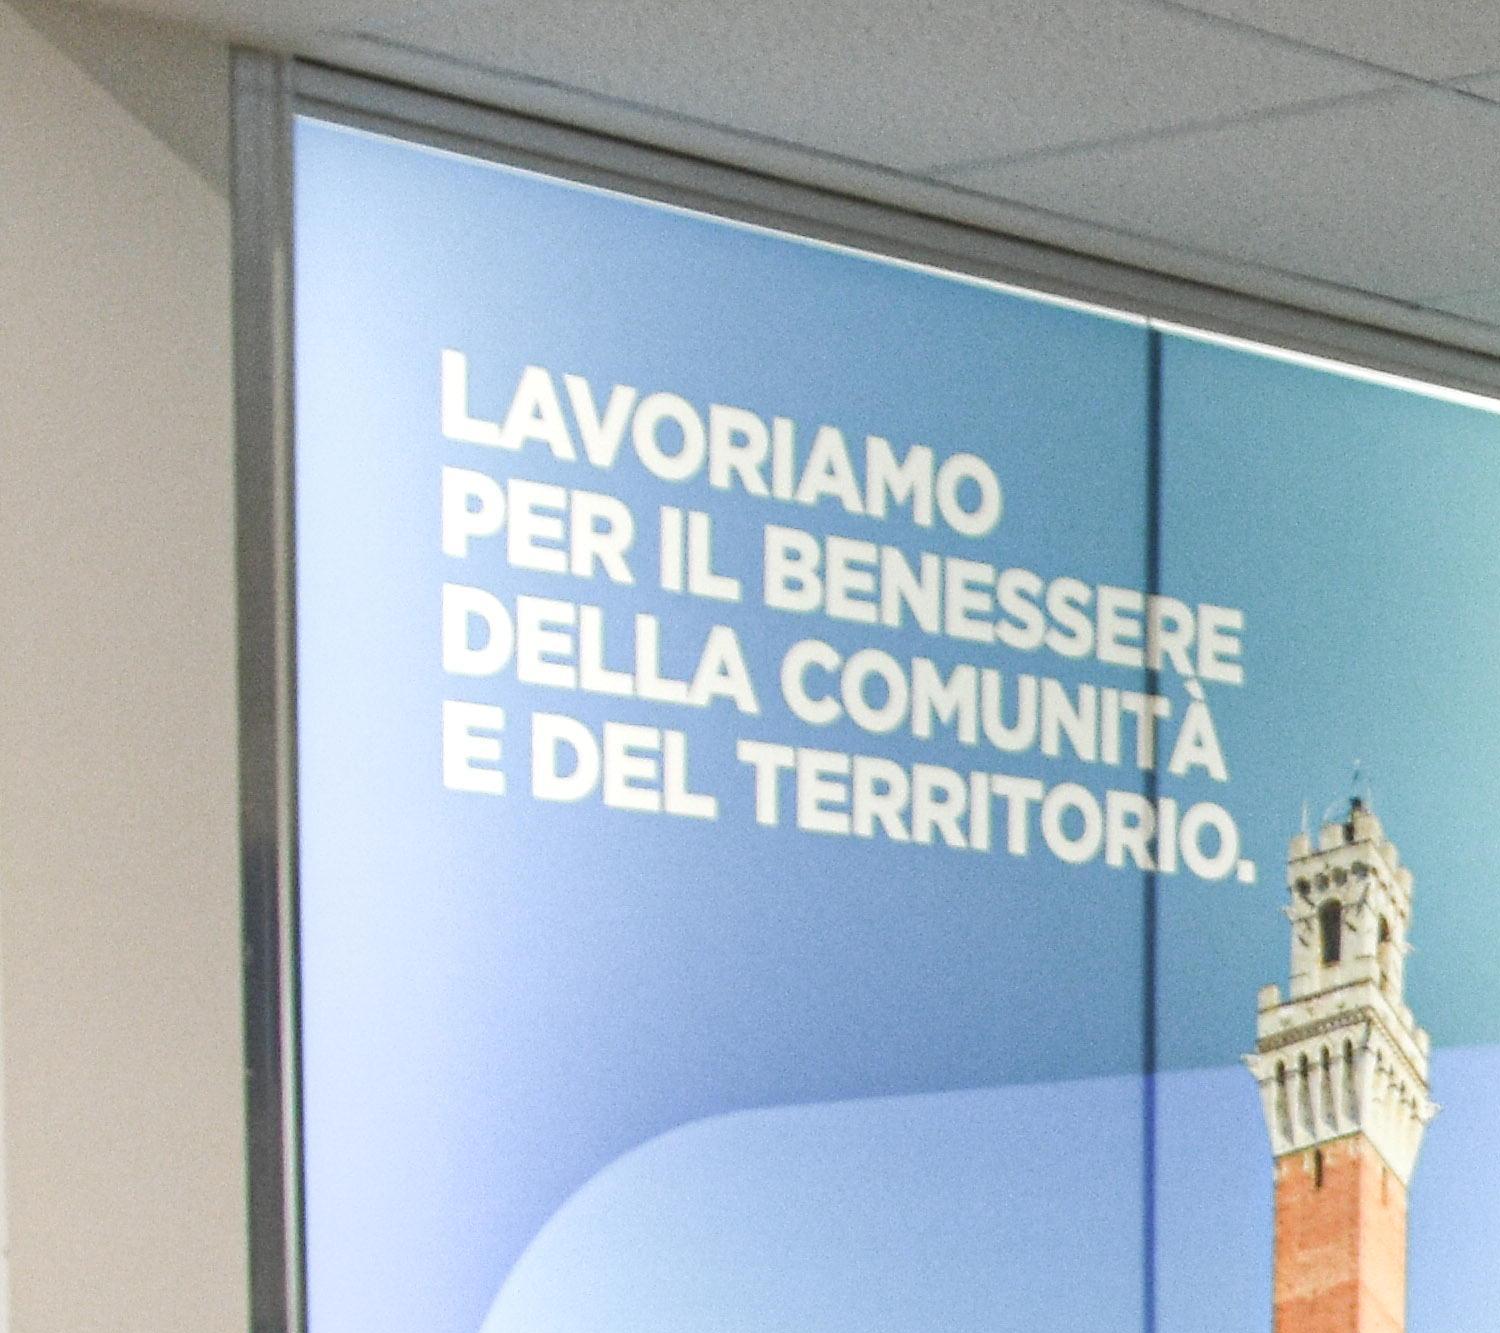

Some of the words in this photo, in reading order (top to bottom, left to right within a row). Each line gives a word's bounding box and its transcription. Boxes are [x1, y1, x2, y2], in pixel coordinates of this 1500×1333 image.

[441, 349, 1002, 538] LAVORIAMO
[441, 466, 634, 584] PER
[659, 506, 740, 602] IL
[763, 525, 1244, 686] BENESSERE
[441, 584, 759, 714] DELLA
[781, 640, 1229, 781] COMUNITÀ
[441, 700, 506, 796] E
[531, 712, 718, 820] DEL
[737, 740, 1257, 884] TERRITORIO.
